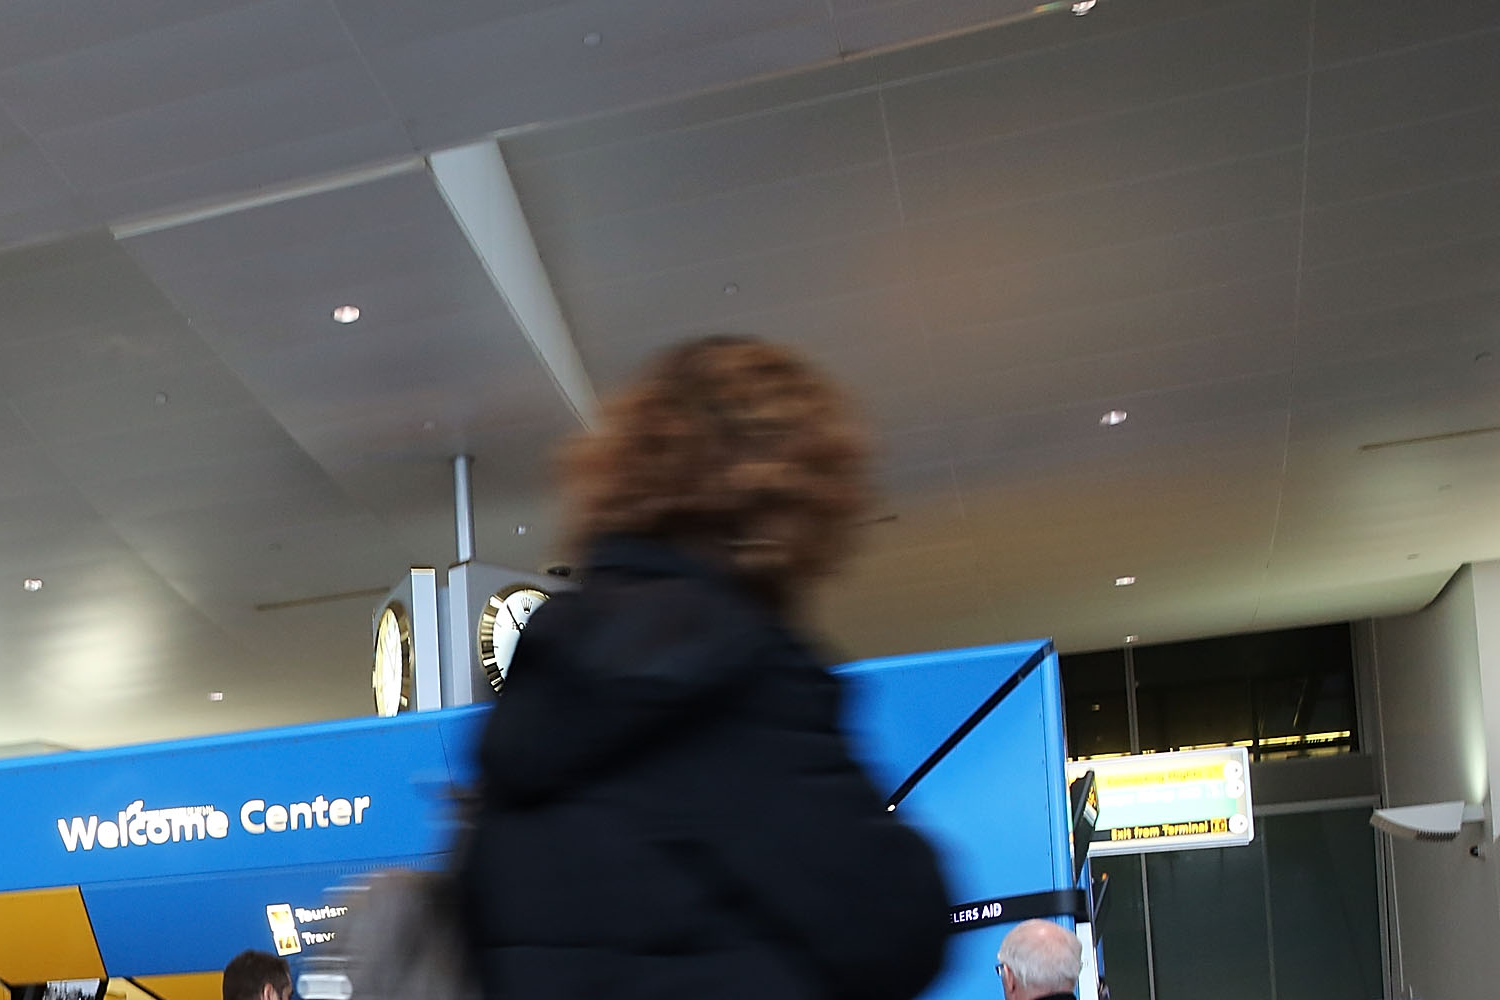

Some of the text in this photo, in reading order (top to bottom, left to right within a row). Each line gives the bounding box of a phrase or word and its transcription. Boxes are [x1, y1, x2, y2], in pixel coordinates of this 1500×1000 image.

[58, 794, 371, 852] Welcome Center
[1133, 825, 1160, 839] from
[1162, 819, 1208, 837] Terminal
[982, 902, 1002, 919] AID
